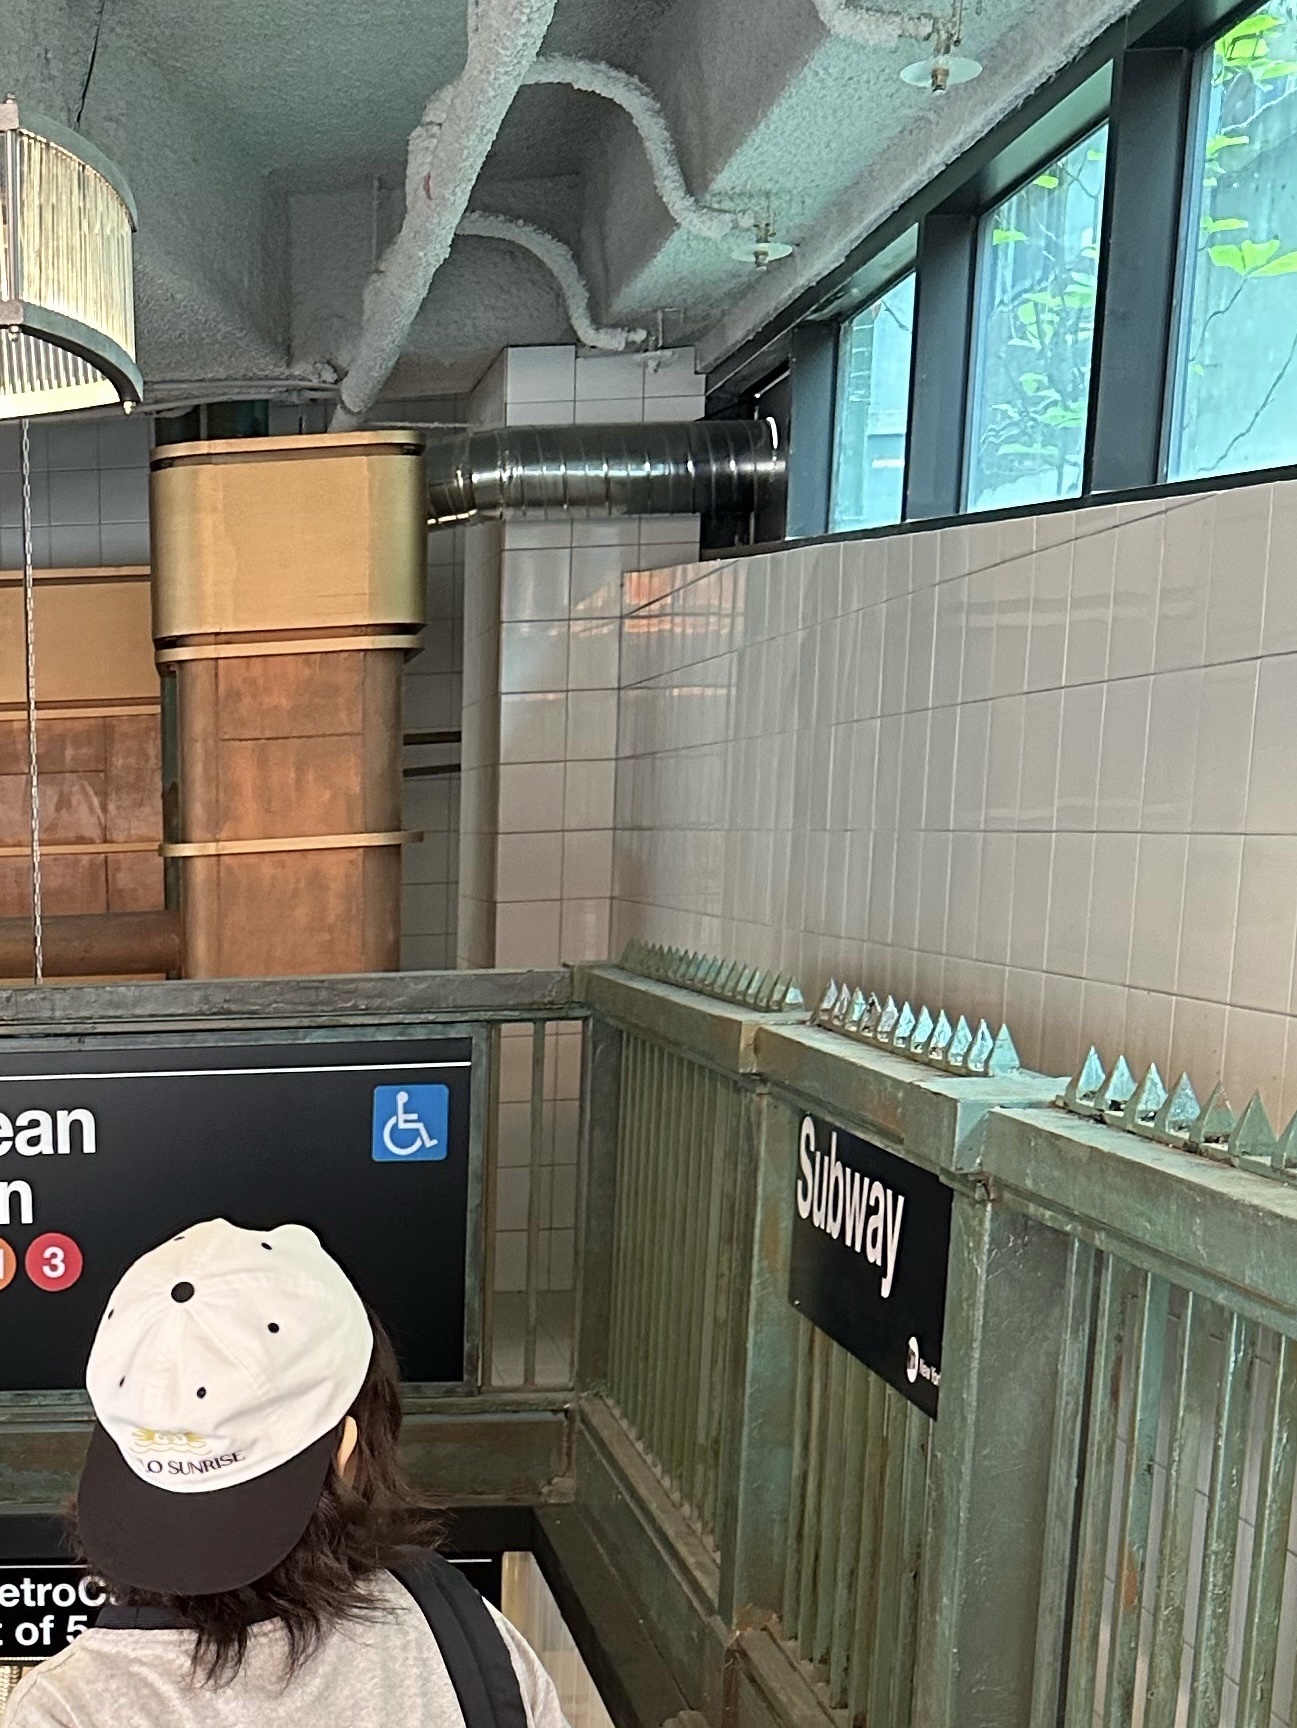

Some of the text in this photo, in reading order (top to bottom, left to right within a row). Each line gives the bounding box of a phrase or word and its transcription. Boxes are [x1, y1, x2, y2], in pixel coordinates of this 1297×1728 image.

[797, 1116, 905, 1298] Subway
[168, 1451, 245, 1475] SUNRISE
[15, 1614, 55, 1646] of
